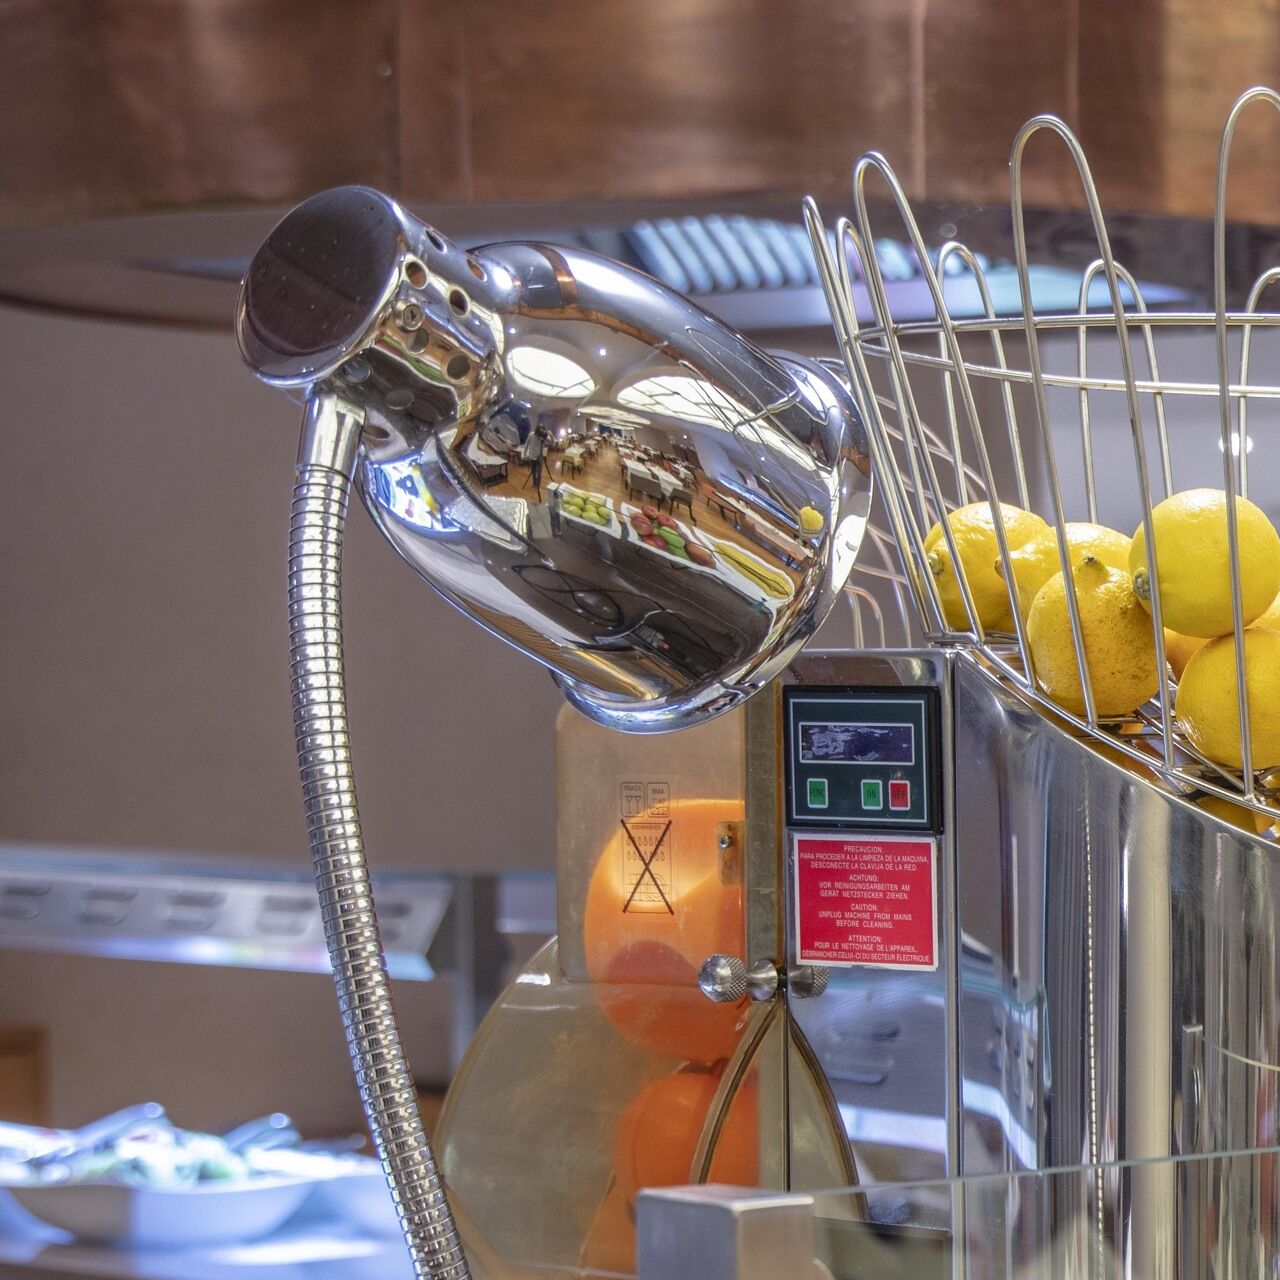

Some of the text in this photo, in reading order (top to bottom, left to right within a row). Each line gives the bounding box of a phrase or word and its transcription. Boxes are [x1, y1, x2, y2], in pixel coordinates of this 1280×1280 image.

[866, 789, 877, 799] ON
[892, 789, 907, 800] OFF
[811, 861, 849, 869] DESCONECTE
[835, 882, 898, 891] REINIGUNGSARBEITEN
[842, 943, 873, 951] NETTOYAGE
[871, 953, 895, 961] SECTEUR
